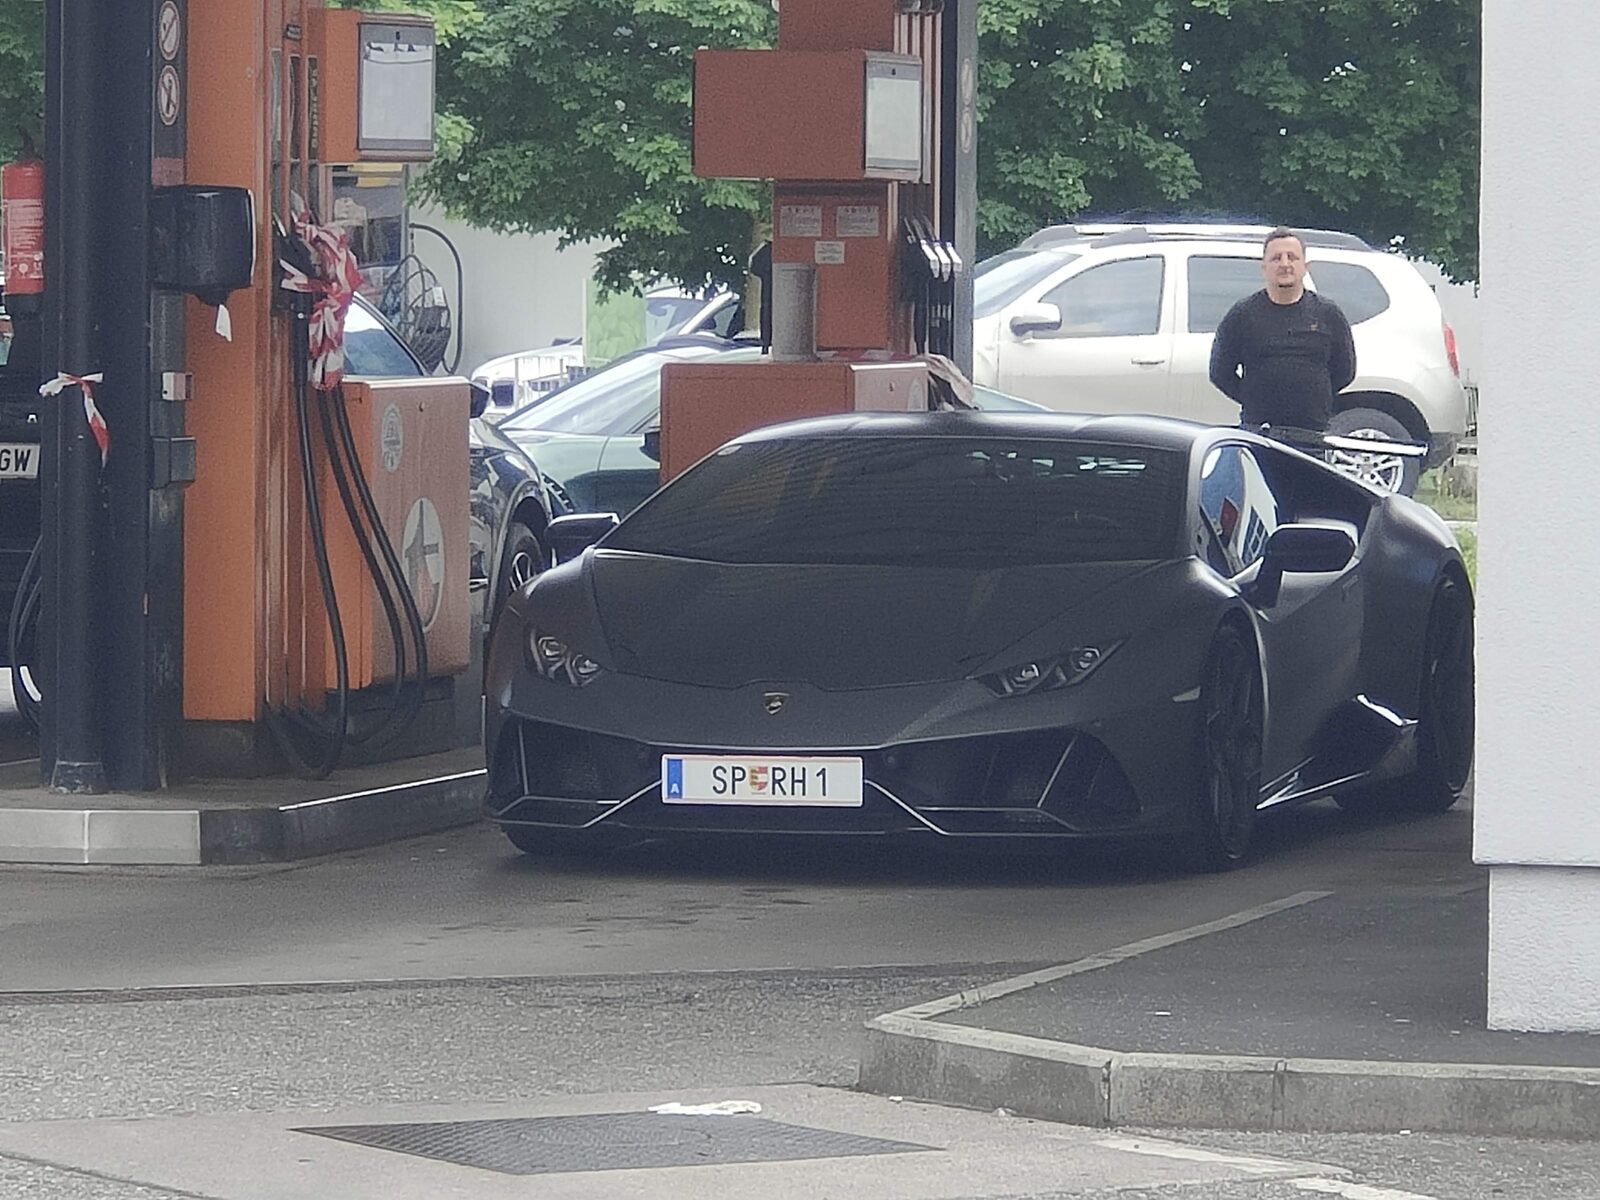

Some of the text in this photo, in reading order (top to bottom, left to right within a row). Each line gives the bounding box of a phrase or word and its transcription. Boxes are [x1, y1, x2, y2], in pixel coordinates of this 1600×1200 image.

[670, 783, 680, 795] A
[712, 765, 827, 797] SP RH 1
